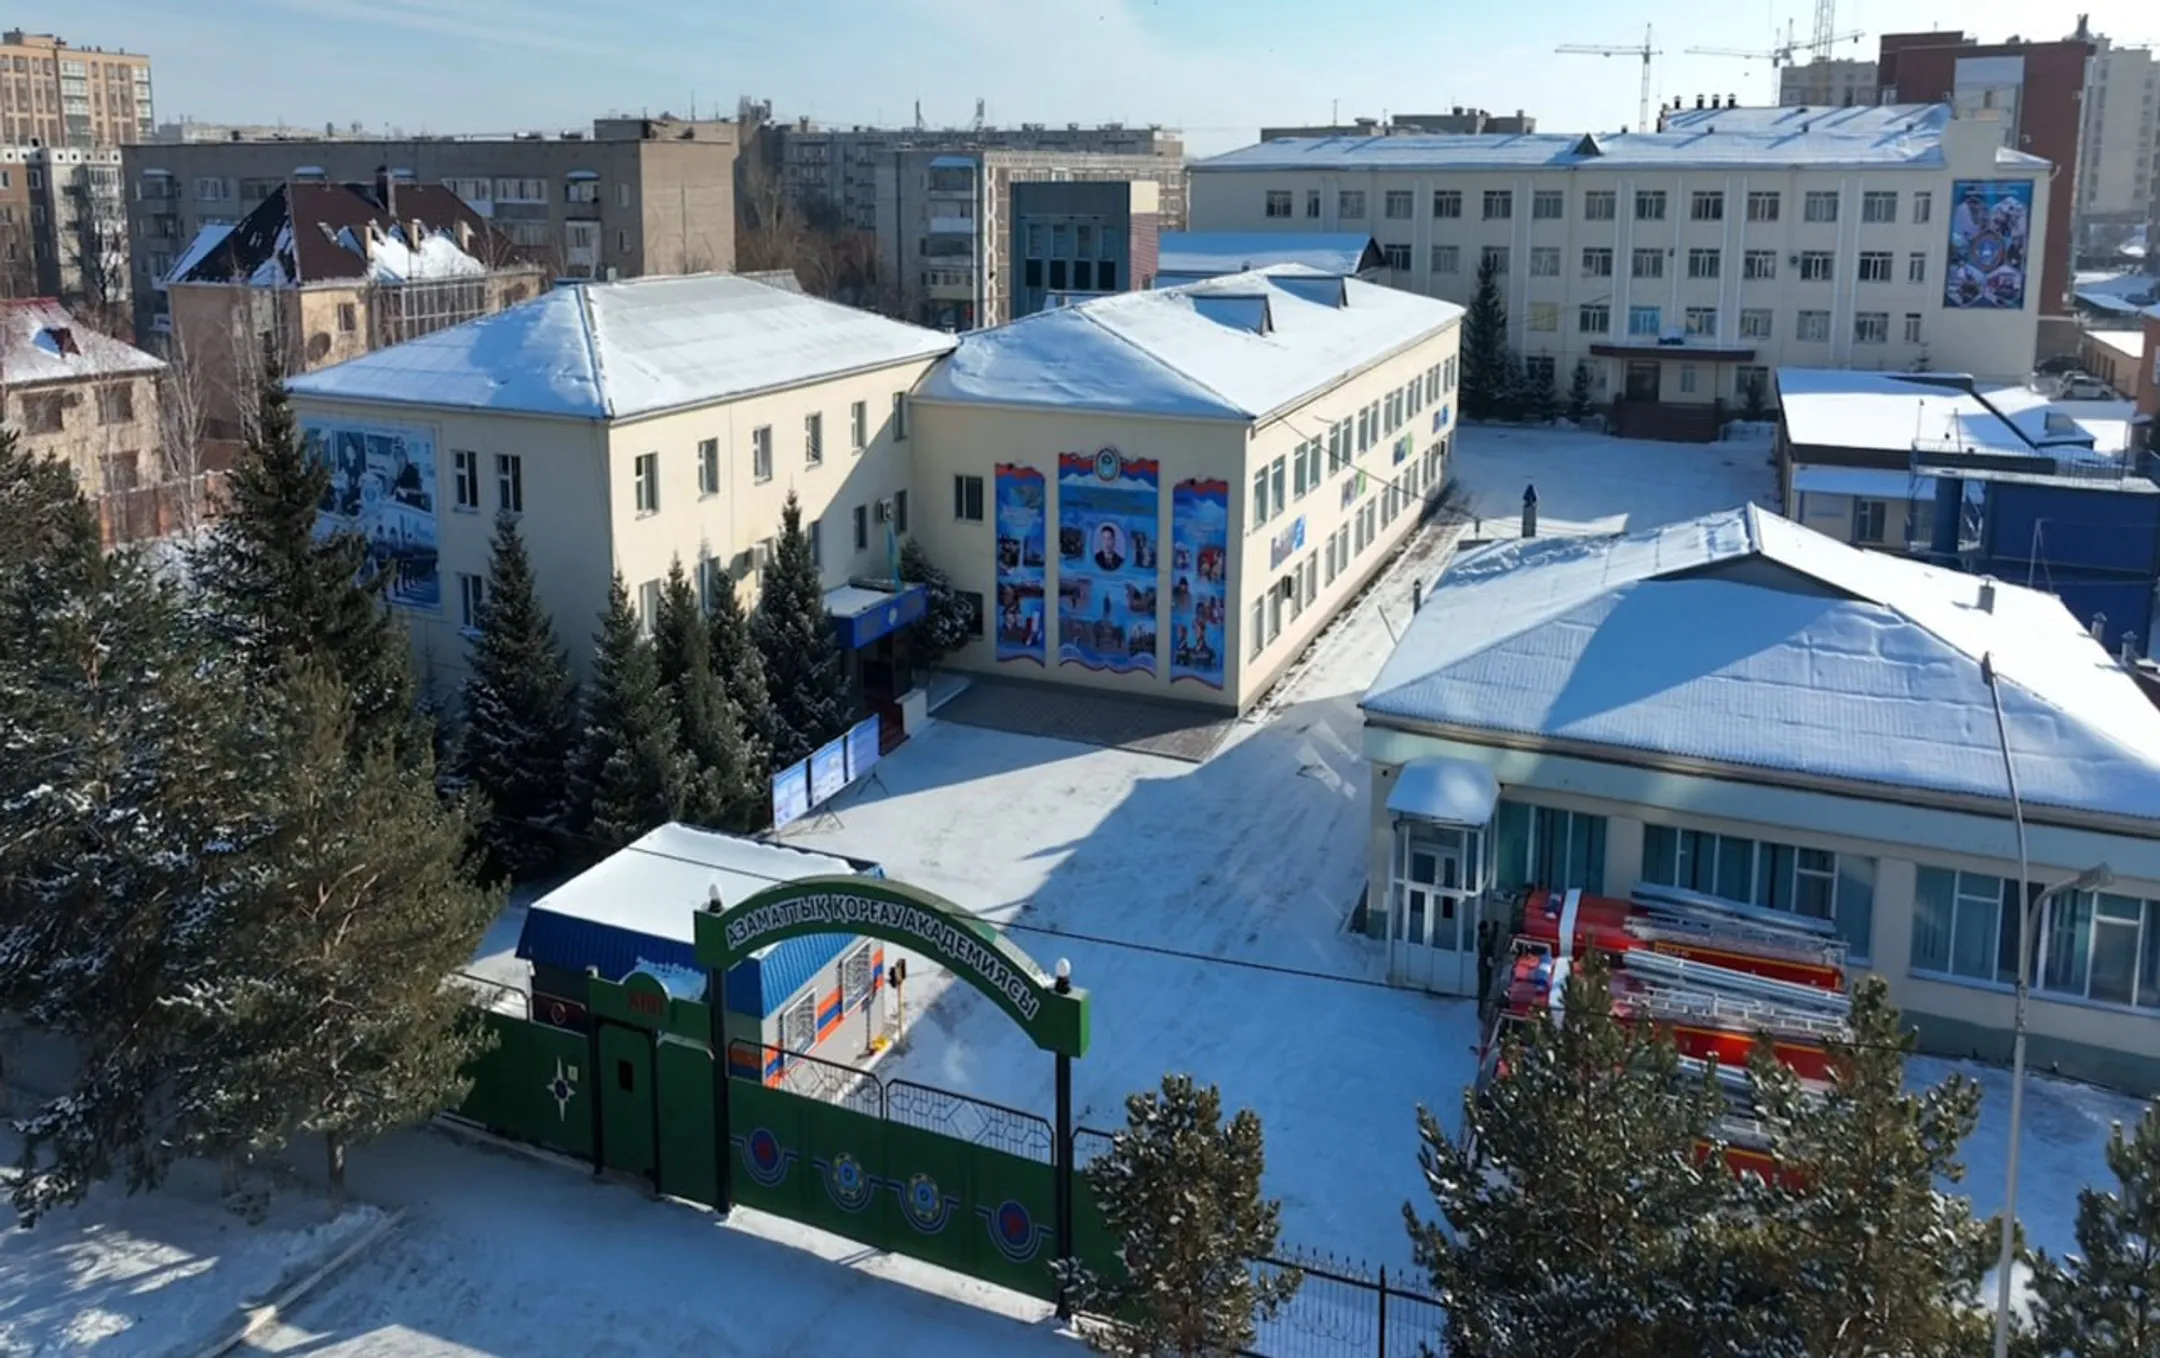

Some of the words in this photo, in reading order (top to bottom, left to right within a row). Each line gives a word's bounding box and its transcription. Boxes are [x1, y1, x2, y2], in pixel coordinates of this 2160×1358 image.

[725, 894, 831, 951] АЗАМАТТЫҚ
[831, 894, 904, 926] ҚОРҒАУ
[903, 907, 1040, 1021] АКАДЕМИЯСЫ
